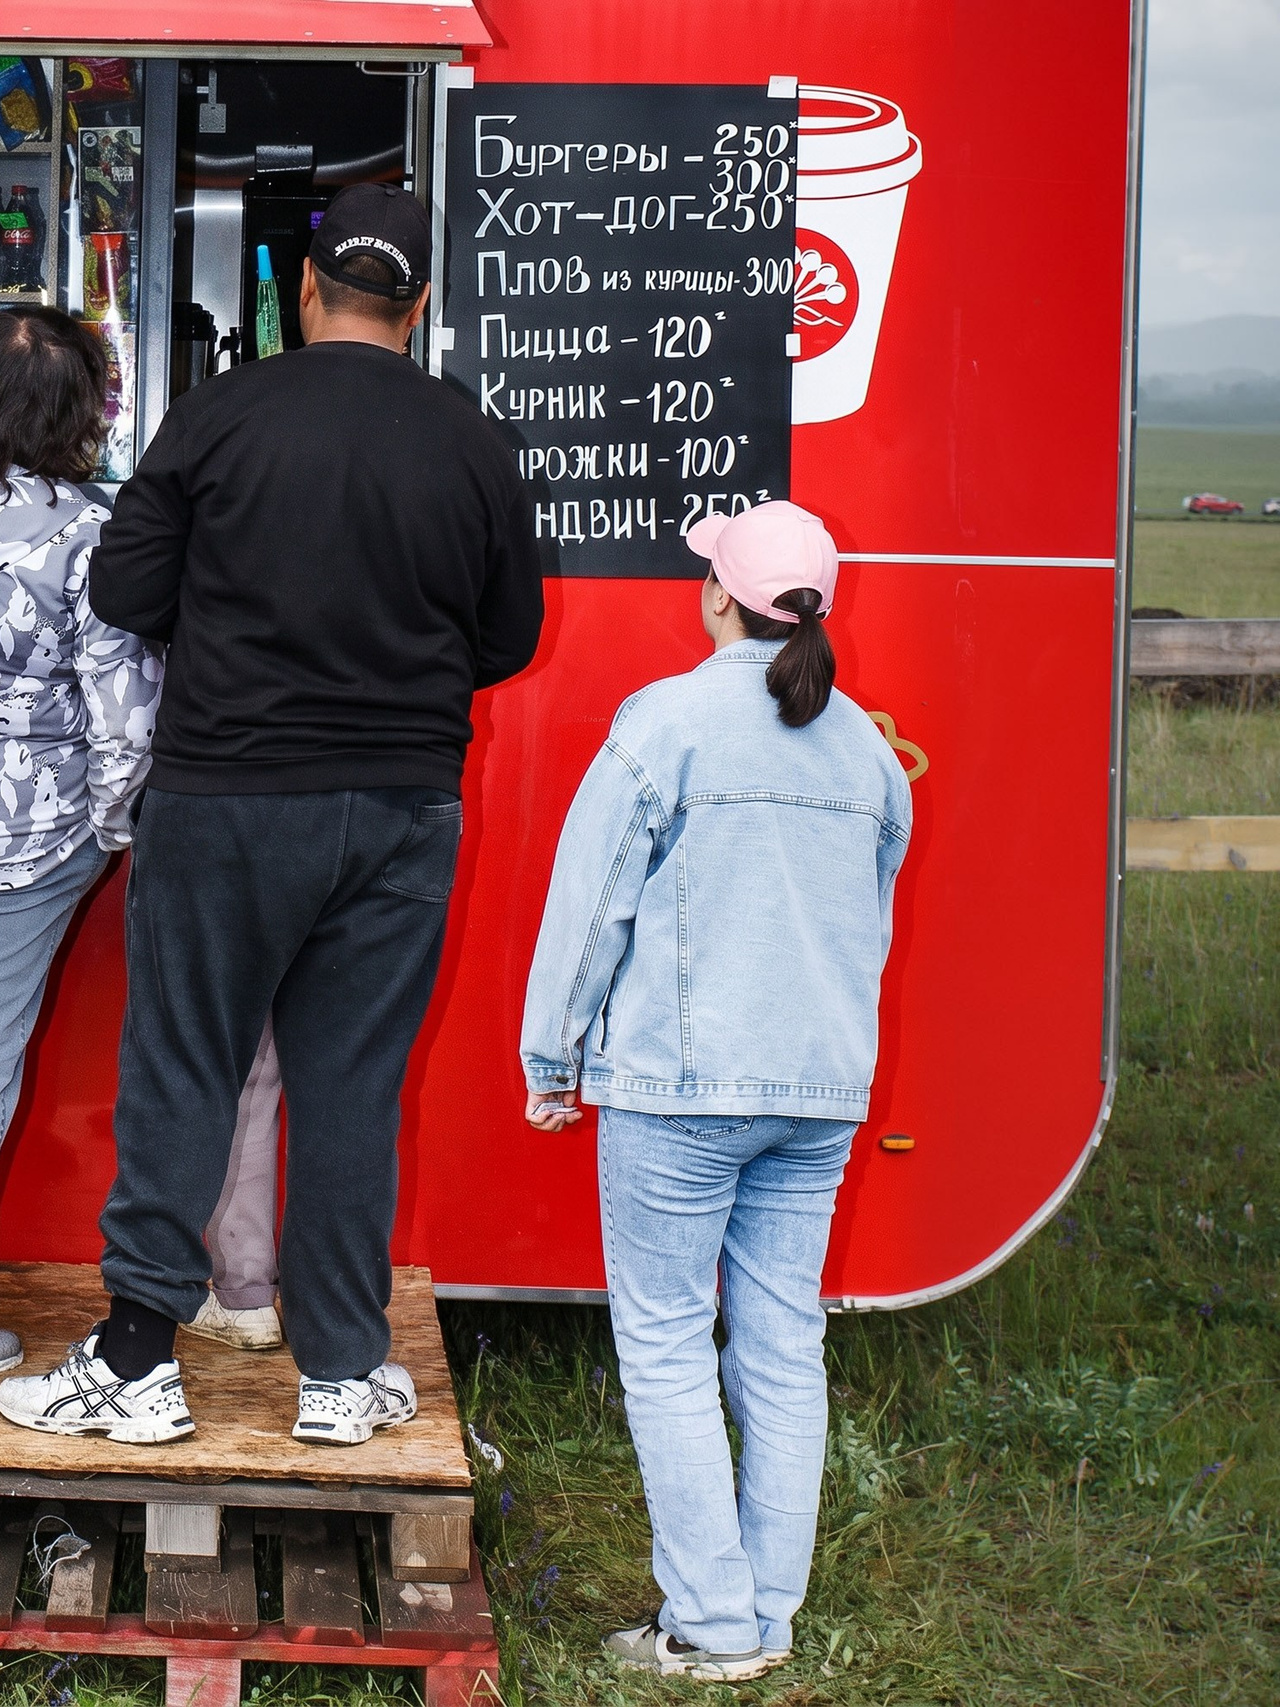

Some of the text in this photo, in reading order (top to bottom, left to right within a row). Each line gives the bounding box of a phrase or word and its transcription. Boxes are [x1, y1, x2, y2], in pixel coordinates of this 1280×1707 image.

[475, 115, 668, 178] Бургеры
[477, 251, 591, 298] Плов
[602, 269, 632, 292] из
[480, 313, 611, 363] Пицца
[480, 373, 607, 422] Курник
[519, 442, 648, 481] рожки
